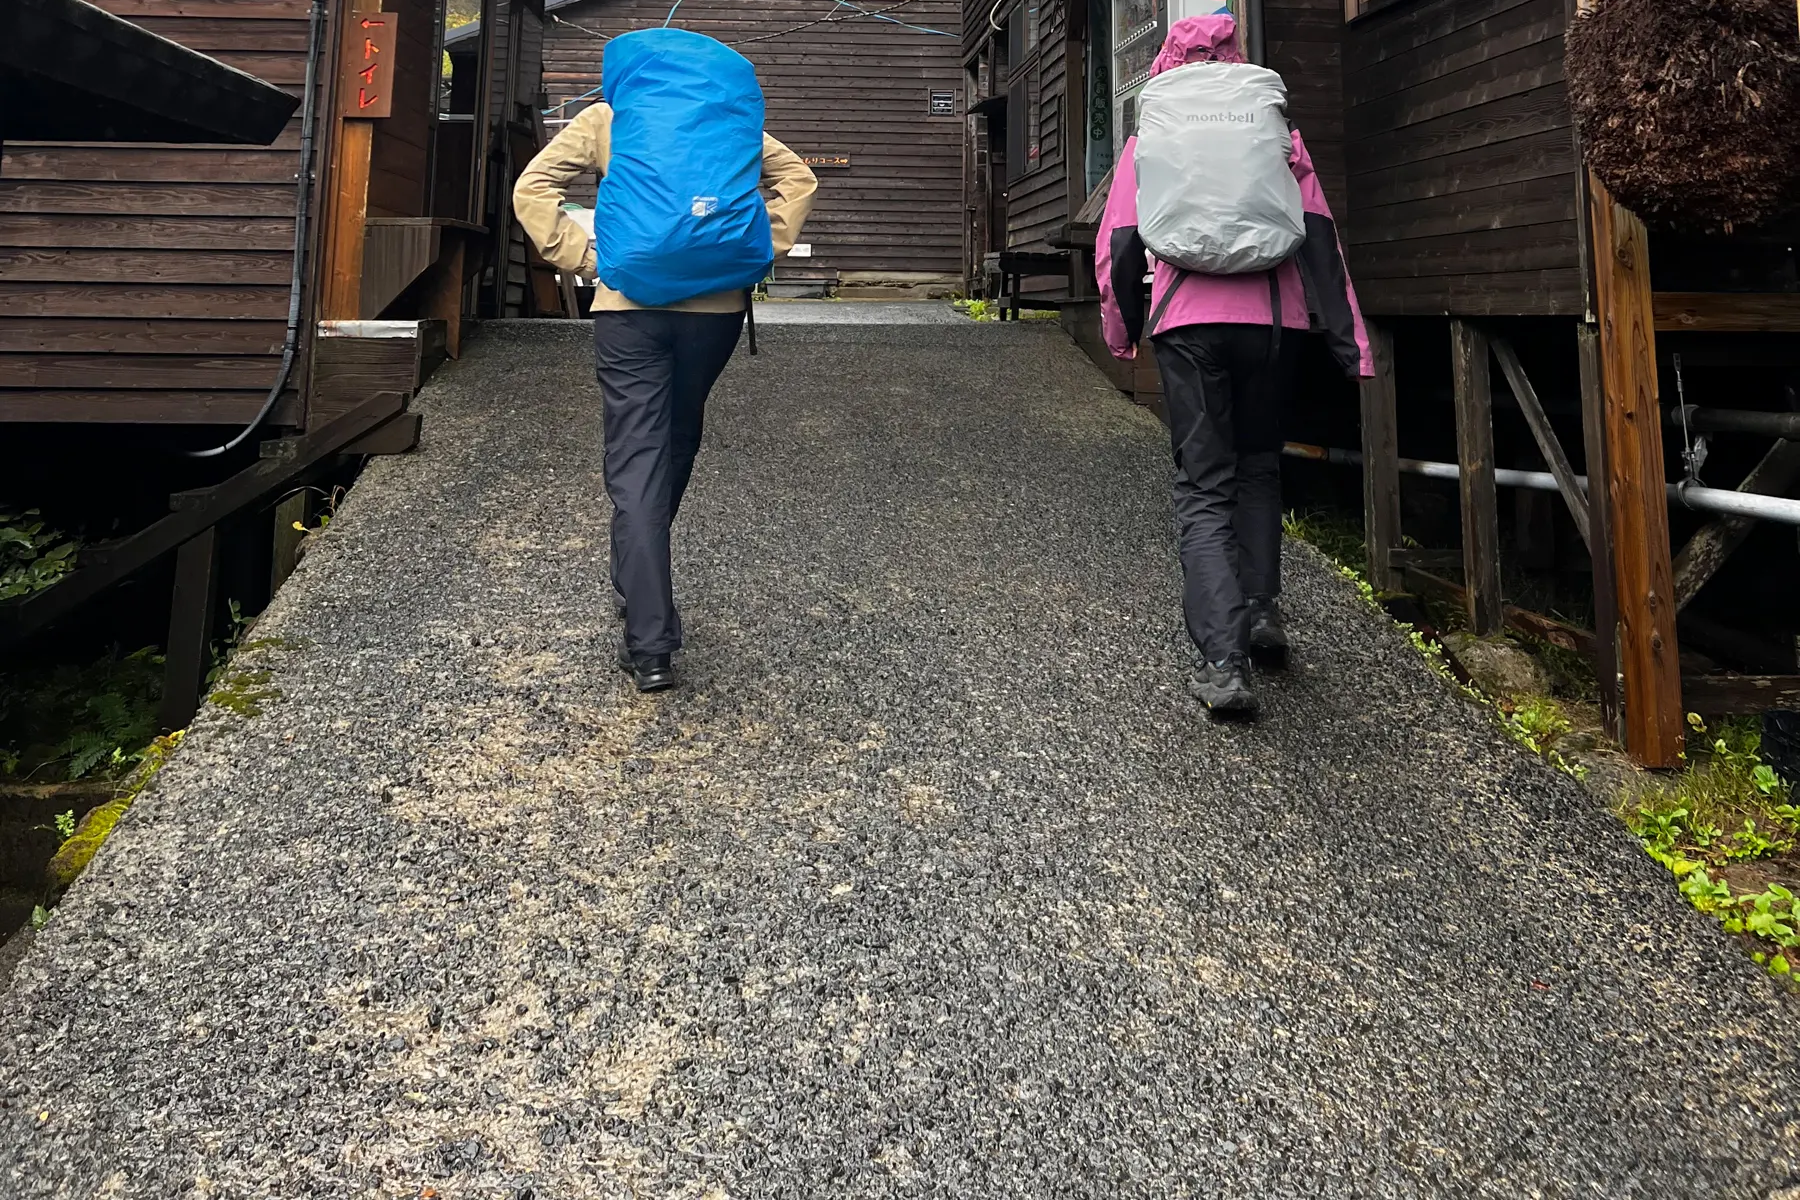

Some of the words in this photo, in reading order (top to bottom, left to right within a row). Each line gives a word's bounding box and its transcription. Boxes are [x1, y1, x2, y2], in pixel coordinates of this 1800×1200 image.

[359, 37, 380, 109] トイレ
[801, 156, 840, 164] もりコース
